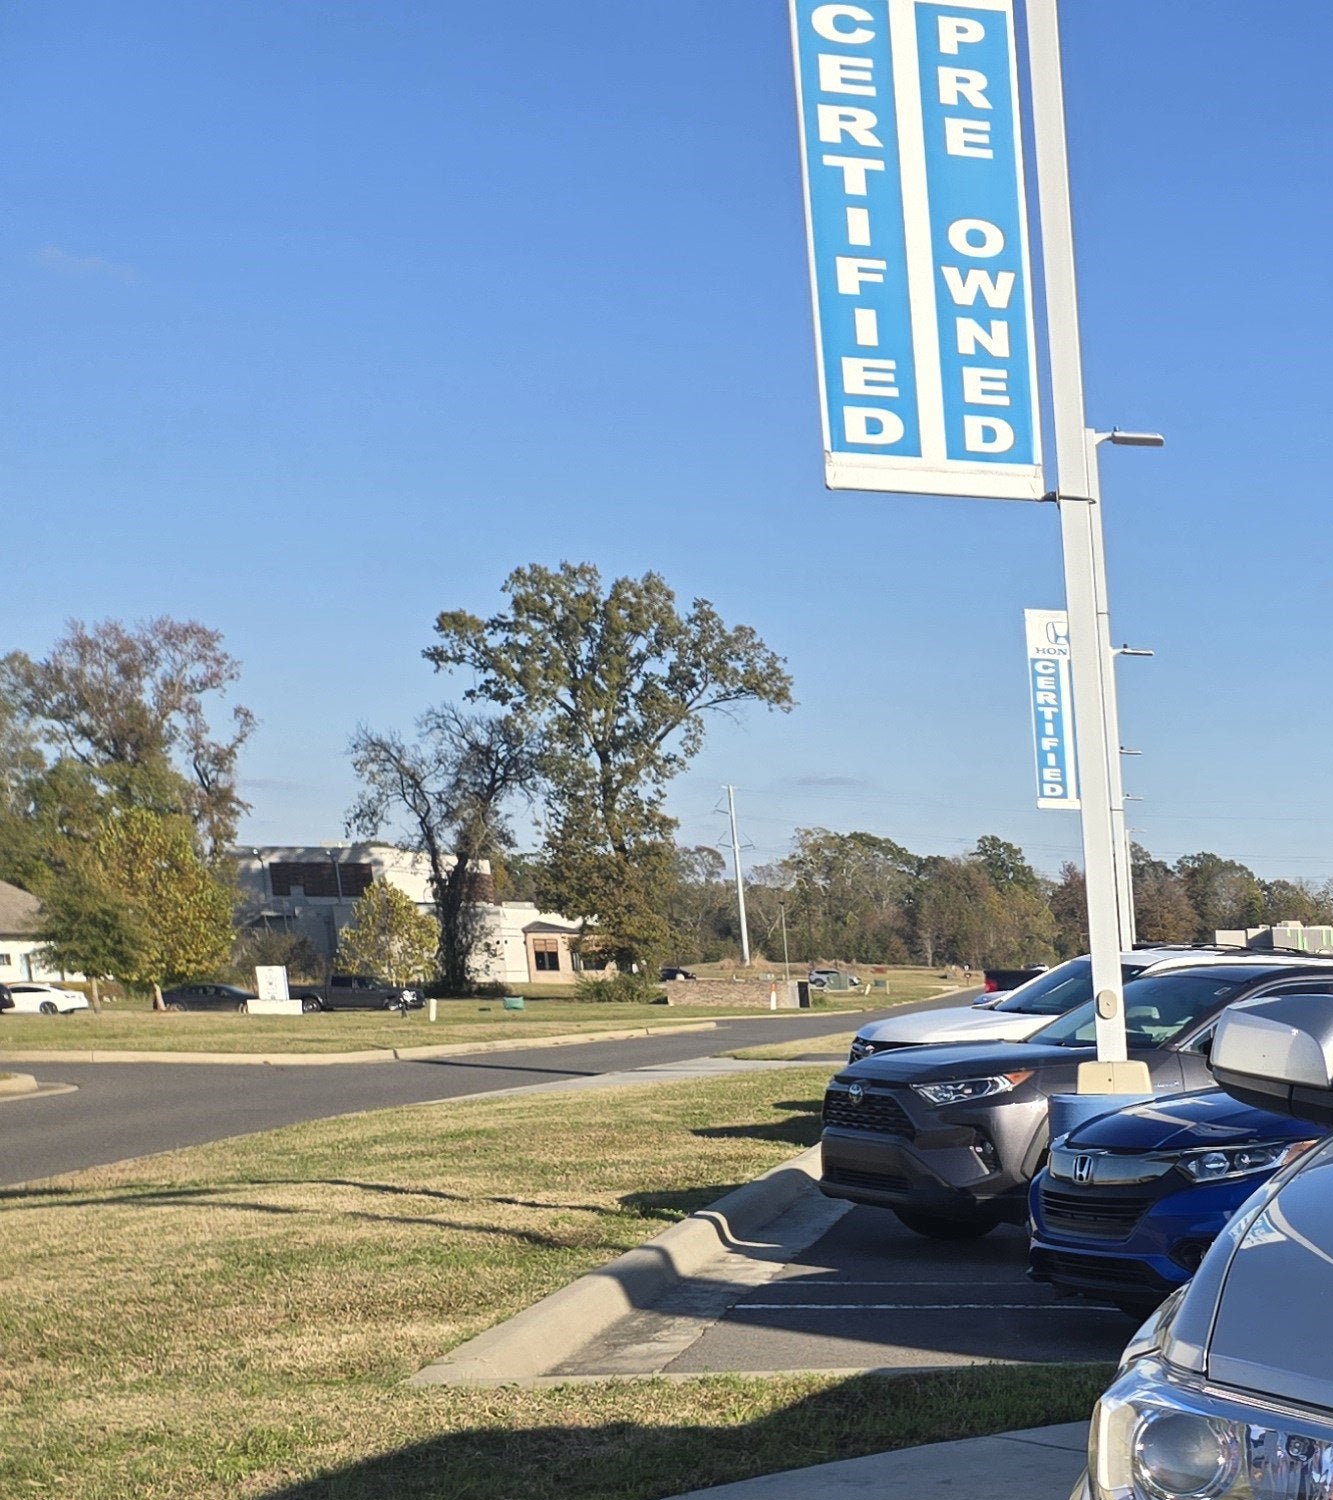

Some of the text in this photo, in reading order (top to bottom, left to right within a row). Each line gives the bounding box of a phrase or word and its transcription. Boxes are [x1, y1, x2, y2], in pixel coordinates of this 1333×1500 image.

[811, 4, 905, 446] CERTIFIED
[937, 14, 1016, 454] PRE OWNED
[1034, 660, 1064, 797] CERTIFIED
